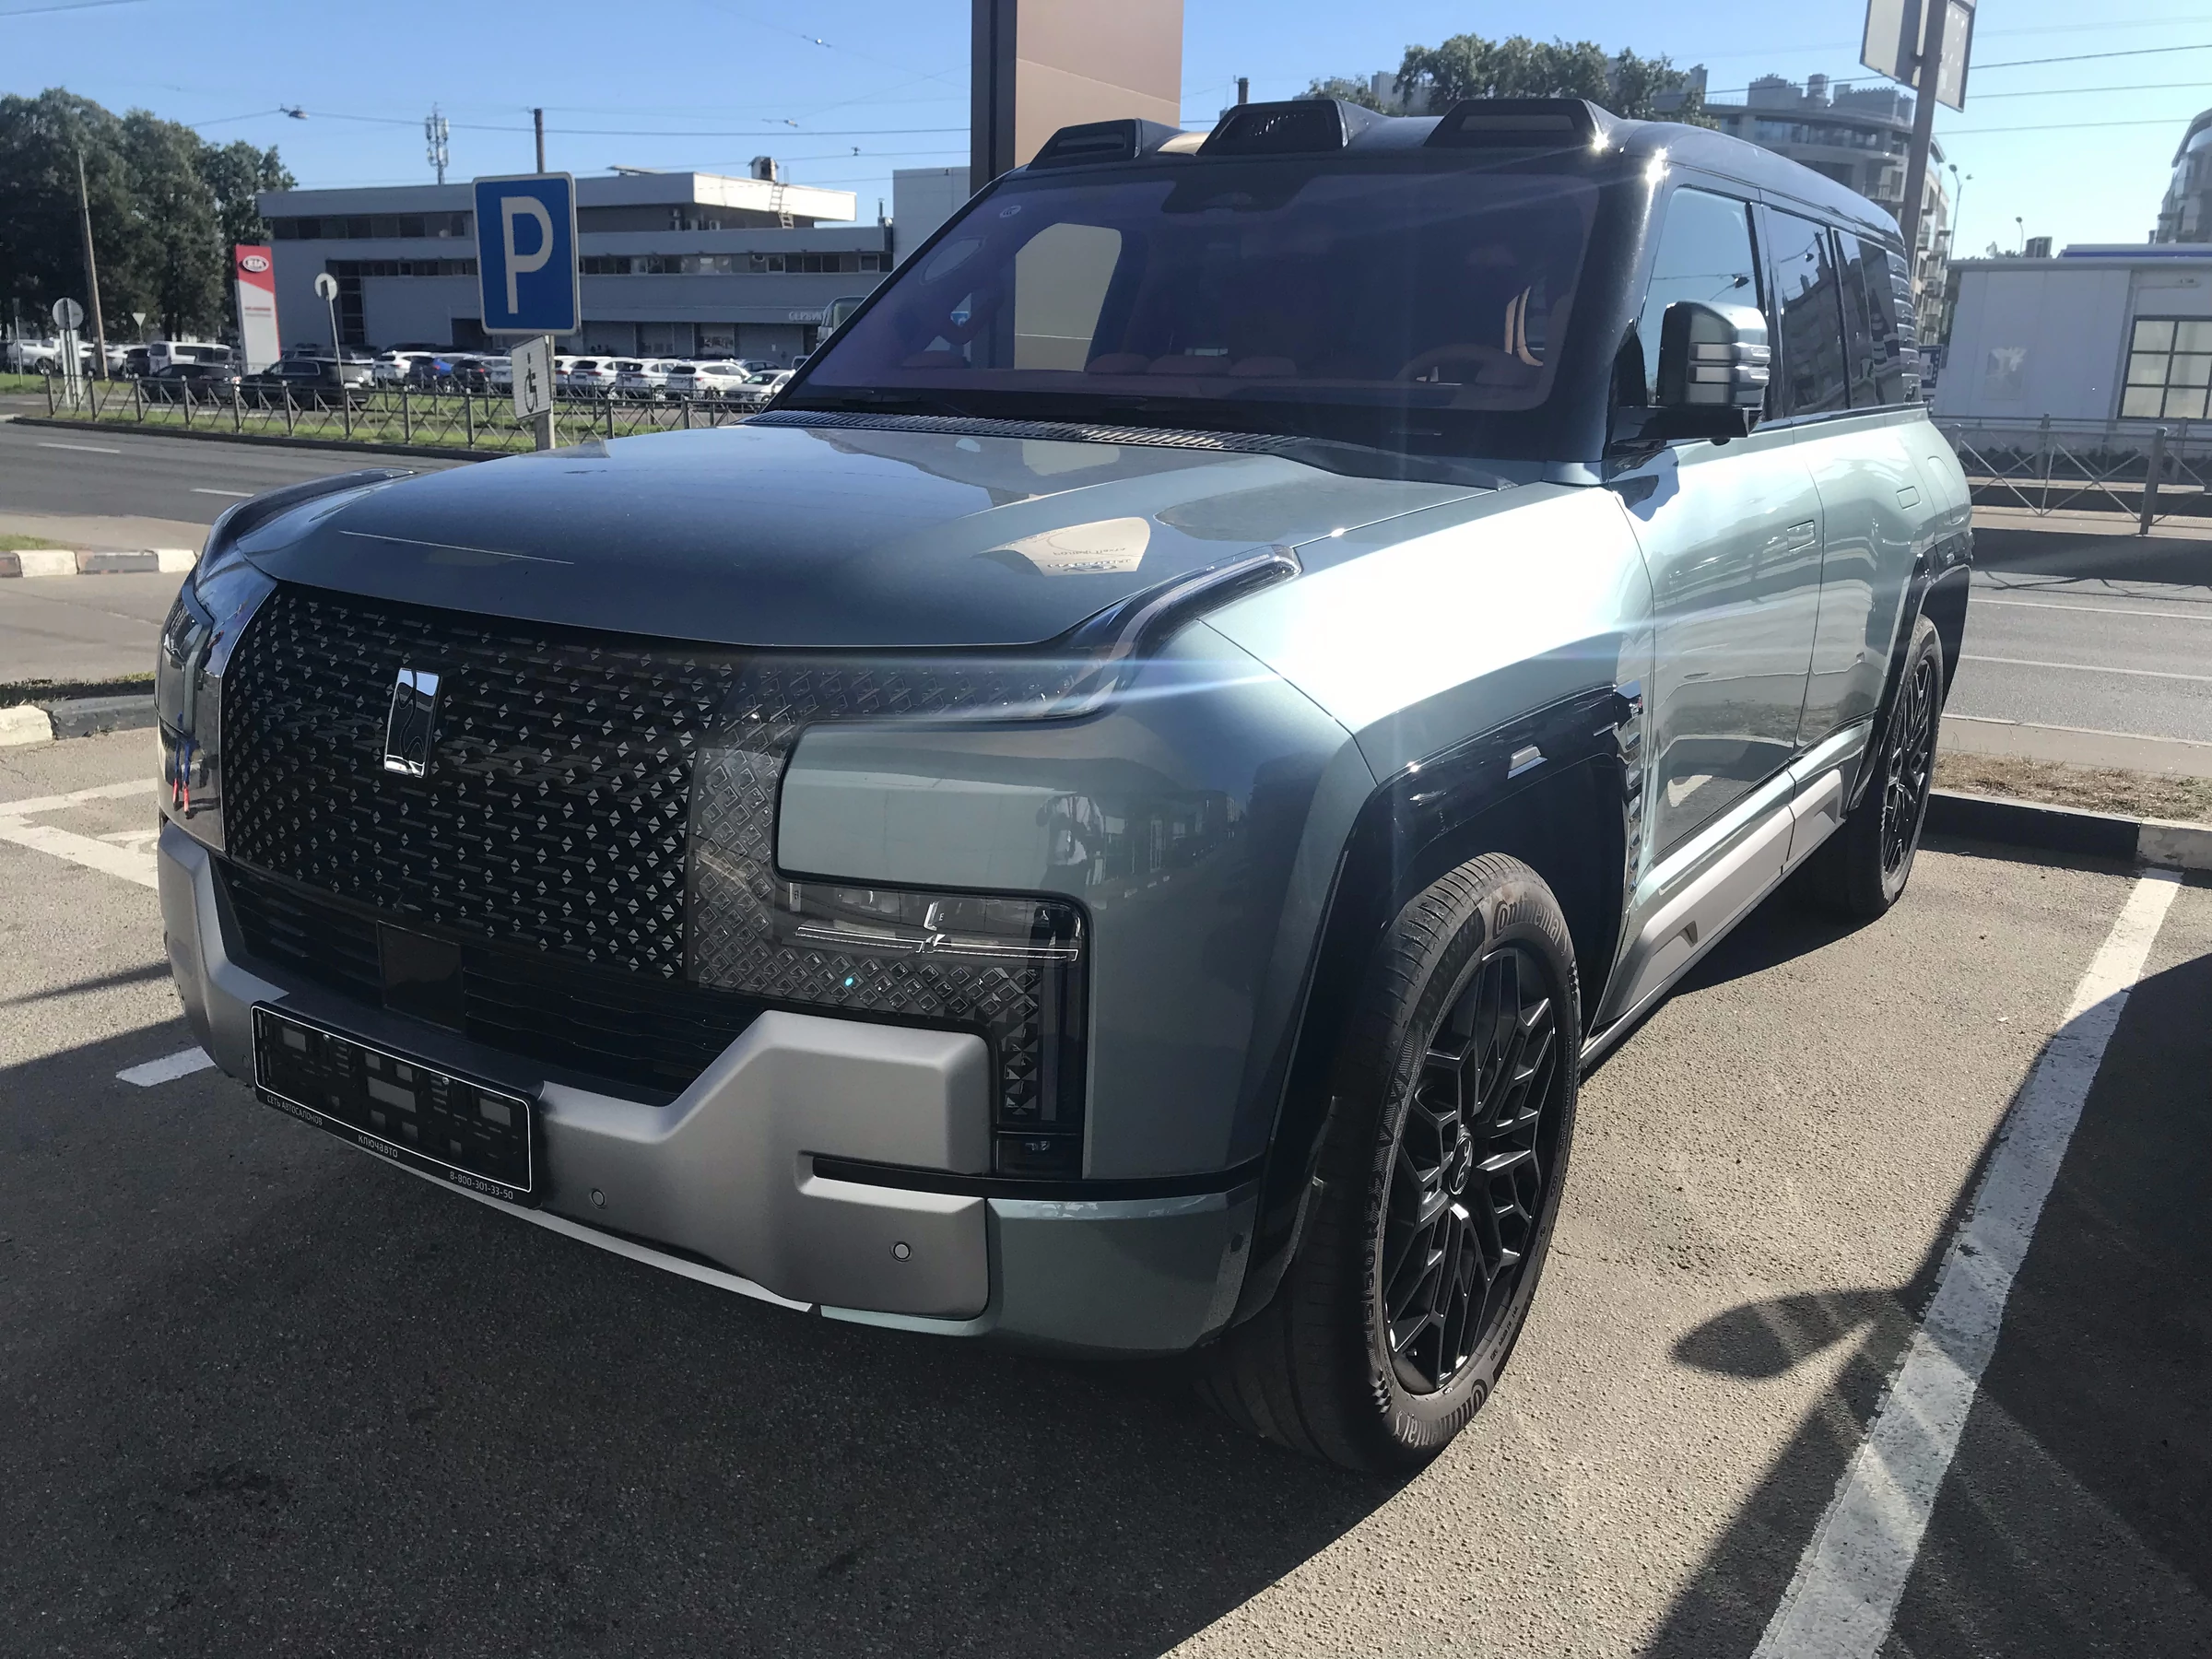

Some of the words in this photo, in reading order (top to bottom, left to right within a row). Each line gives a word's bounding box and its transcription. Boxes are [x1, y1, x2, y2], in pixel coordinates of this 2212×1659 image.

[500, 196, 554, 314] P
[1491, 891, 1564, 947] Continental
[266, 1094, 281, 1108] СЕТЬ
[281, 1100, 323, 1126] АВТОСАЛОНОВ
[449, 1171, 513, 1200] 8-800-301-33-50
